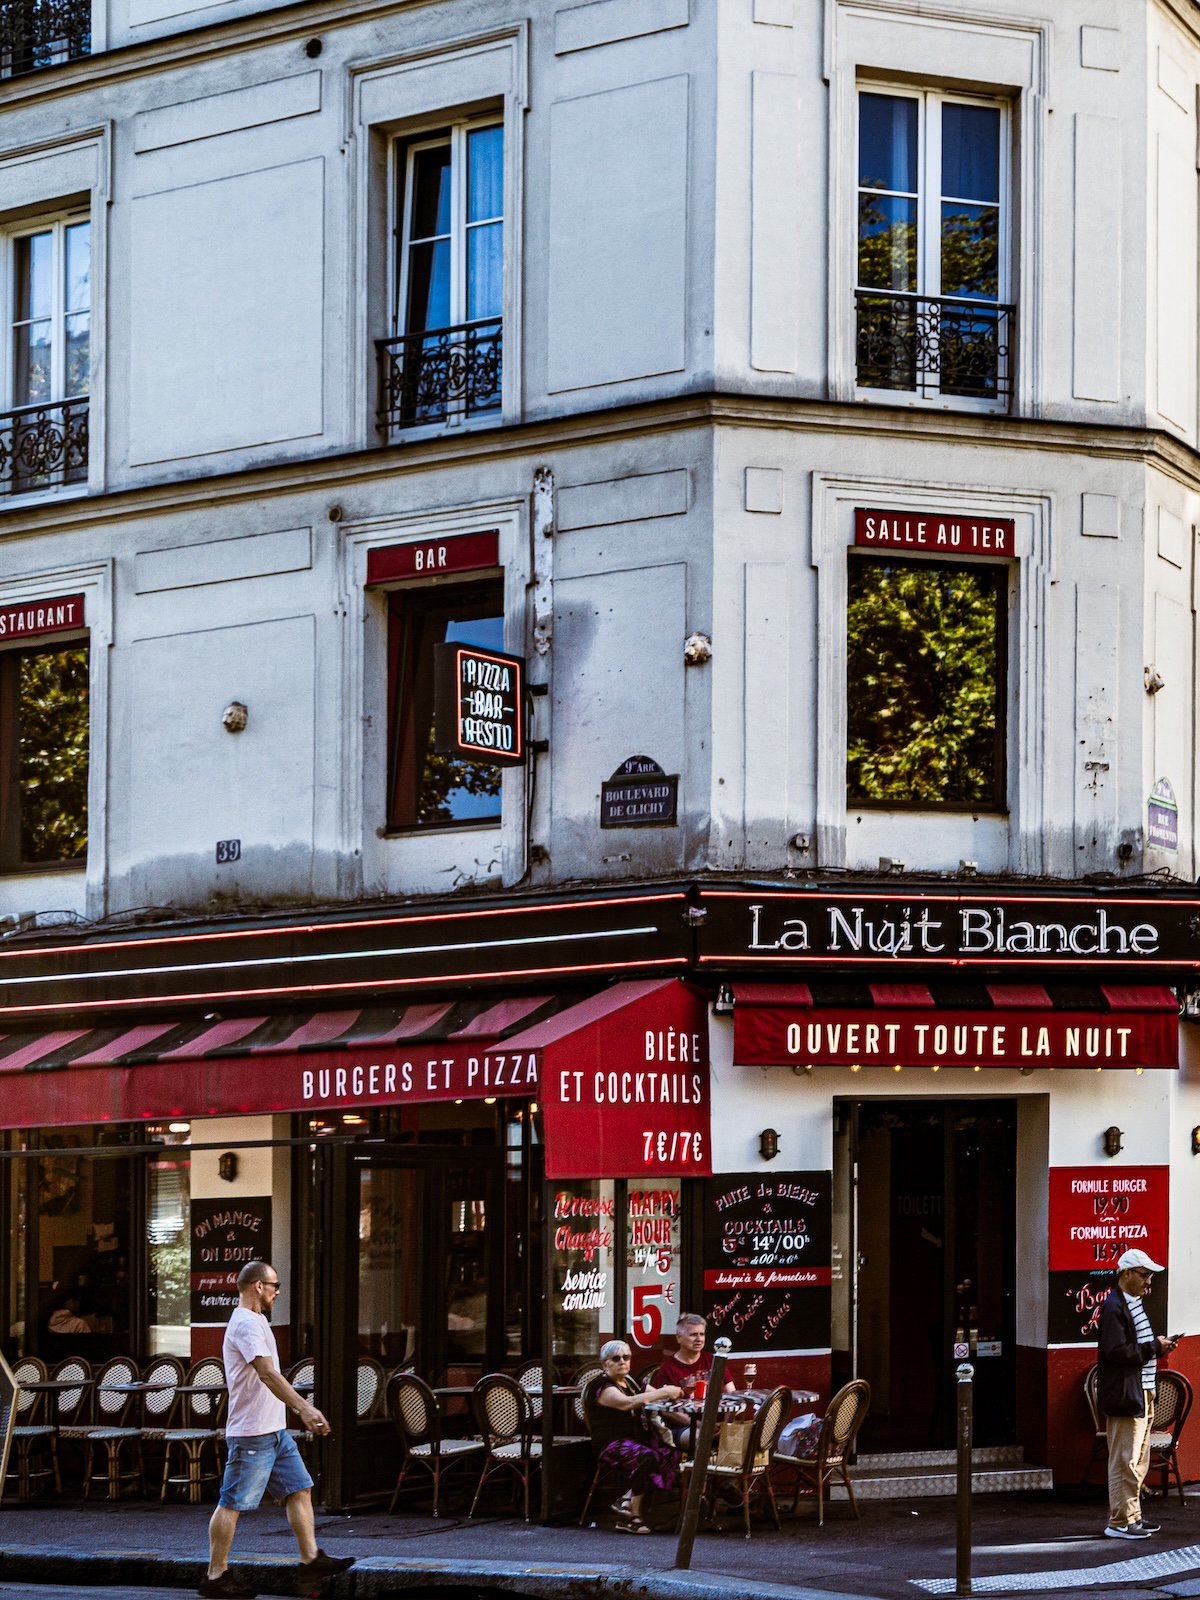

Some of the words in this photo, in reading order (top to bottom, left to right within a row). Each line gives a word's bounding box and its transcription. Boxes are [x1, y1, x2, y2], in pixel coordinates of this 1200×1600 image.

[865, 517, 927, 540] SALLE
[937, 523, 961, 546] AU
[971, 526, 1005, 549] 1ER
[415, 546, 447, 571] BAR
[462, 659, 510, 692] PIZZA
[461, 717, 512, 750] RESTO
[606, 786, 669, 802] BOULEVARD
[609, 805, 624, 817] DE
[626, 802, 665, 815] CLICHY
[219, 840, 239, 861] 39
[748, 905, 811, 951] La
[827, 906, 945, 958] Nuit
[957, 907, 1160, 954] Blanche
[645, 1026, 700, 1062] BIÈRE
[786, 1022, 901, 1055] OUVERT
[914, 1023, 1006, 1056] TOUTE
[1021, 1026, 1051, 1056] LA
[1065, 1027, 1133, 1058] NUIT
[302, 1062, 413, 1100] BURGERS
[427, 1060, 455, 1090] ET
[467, 1053, 538, 1088] PIZZA
[560, 1071, 585, 1103] ET
[594, 1071, 702, 1104] COCKTAILS
[715, 1185, 751, 1212] PINTE
[757, 1183, 773, 1198] de
[1071, 1179, 1110, 1194] FORMULE
[1112, 1179, 1147, 1193] BURGER
[629, 1189, 681, 1218] HAPPY
[195, 1218, 212, 1239] ON
[211, 1210, 262, 1233] MANGE
[632, 1218, 672, 1246] HOUR
[723, 1218, 808, 1236] COCKTAILS
[1071, 1226, 1117, 1241] FORMULE
[1118, 1225, 1149, 1239] PIZZA
[201, 1247, 219, 1263] ON
[561, 1267, 607, 1290] service
[754, 1272, 765, 1283] la
[763, 1271, 818, 1288] fermeture
[561, 1288, 607, 1311] continu
